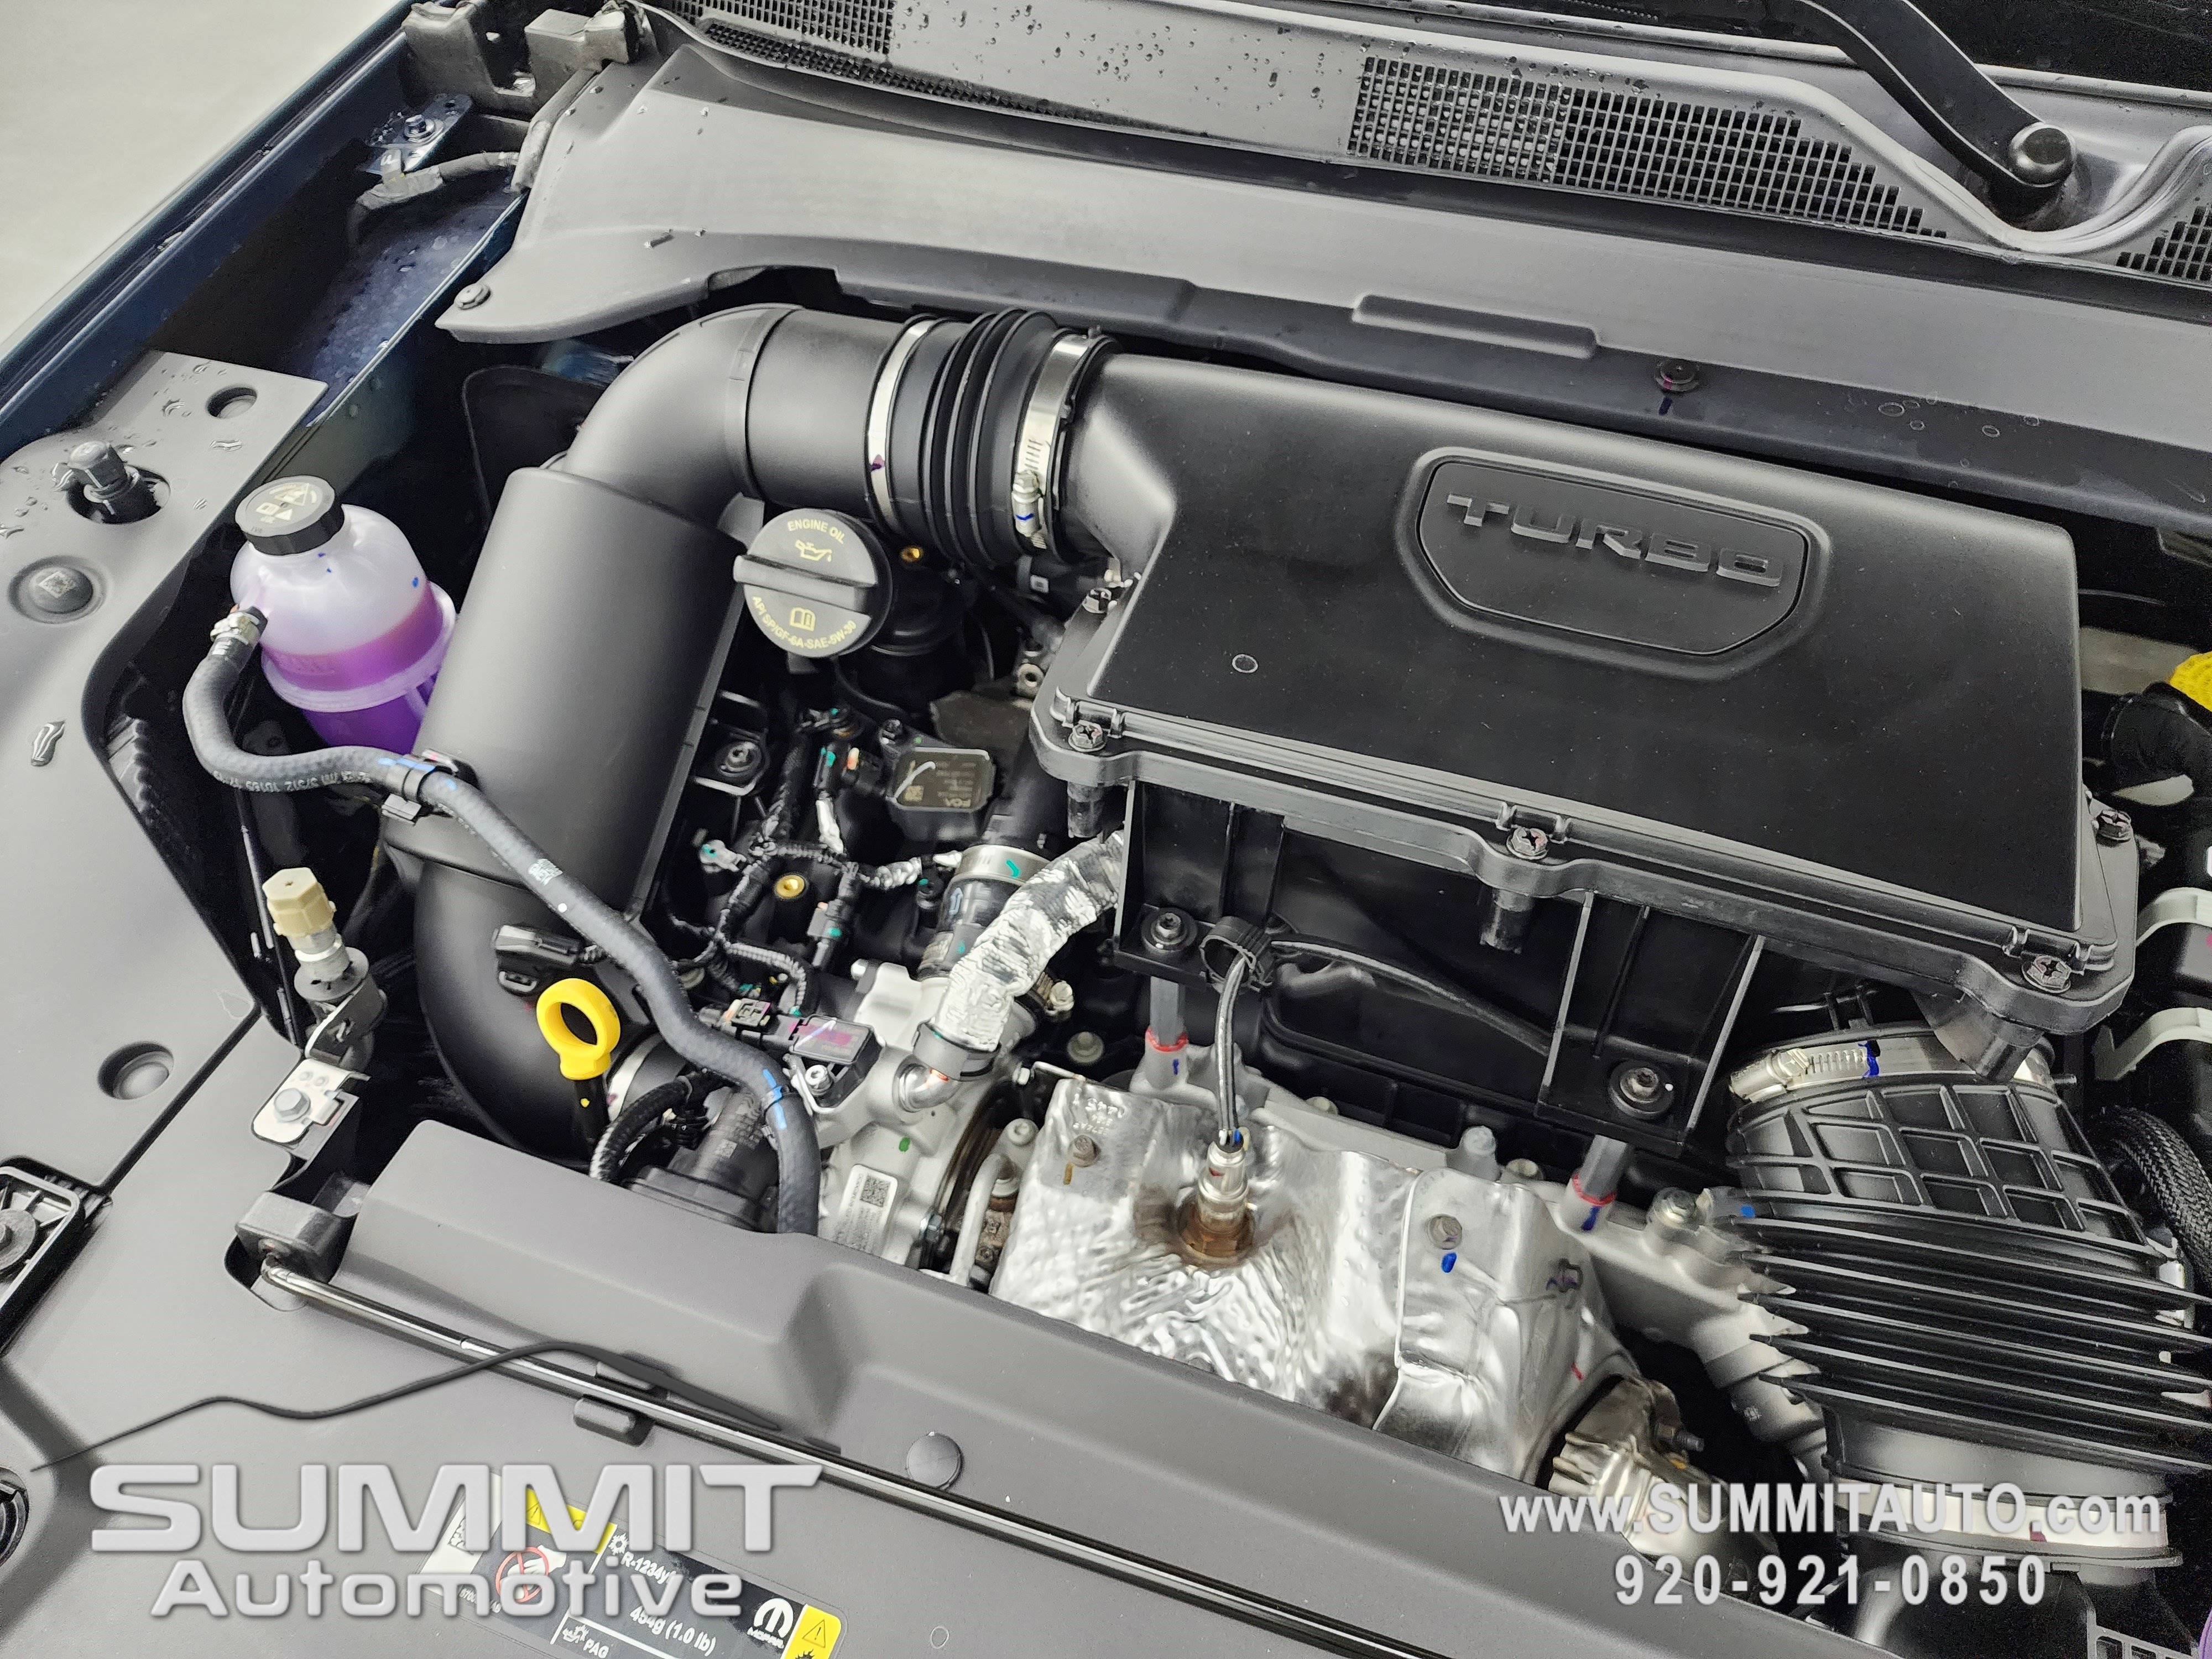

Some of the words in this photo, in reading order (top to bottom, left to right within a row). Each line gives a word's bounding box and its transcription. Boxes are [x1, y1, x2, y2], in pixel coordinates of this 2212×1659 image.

[787, 518, 829, 532] ENGINE
[829, 528, 845, 545] OIL
[1446, 492, 1783, 587] TURBO
[752, 596, 764, 615] API
[583, 1638, 609, 1658] PAG
[665, 1620, 696, 1644] (1.0
[693, 1631, 716, 1657] lb)
